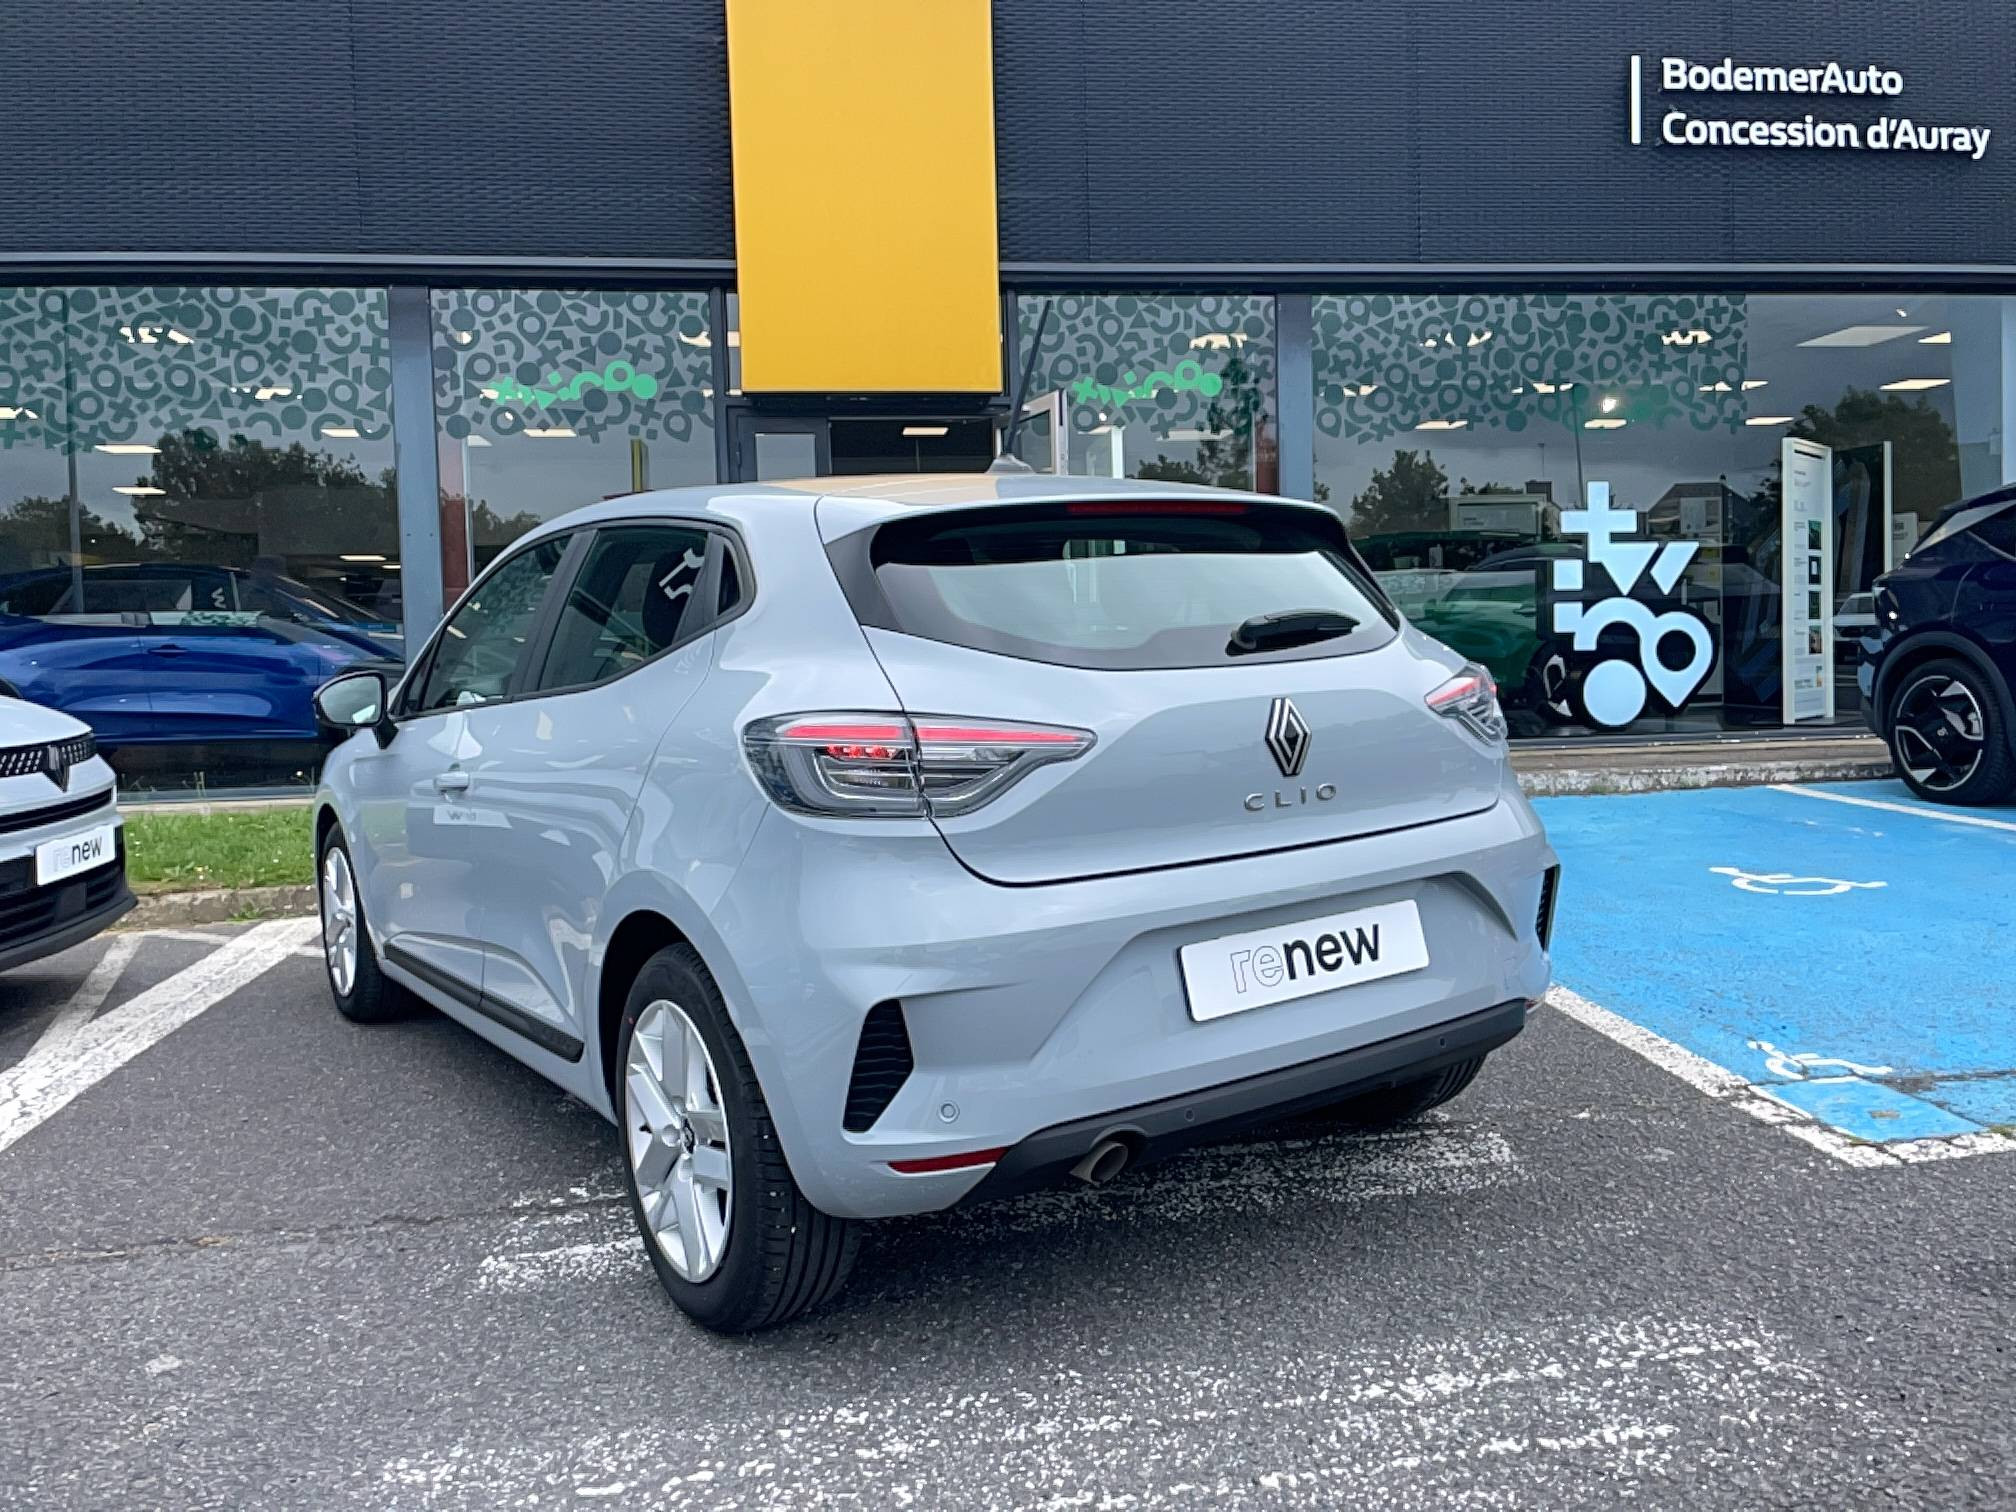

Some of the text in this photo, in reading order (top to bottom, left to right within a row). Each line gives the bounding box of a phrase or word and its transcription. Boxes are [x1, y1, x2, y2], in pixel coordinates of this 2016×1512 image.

[1661, 57, 1904, 96] BodemerAuto
[1662, 112, 1992, 160] Concession d'Auray
[1243, 782, 1337, 811] CLIO
[1230, 923, 1380, 994] renew
